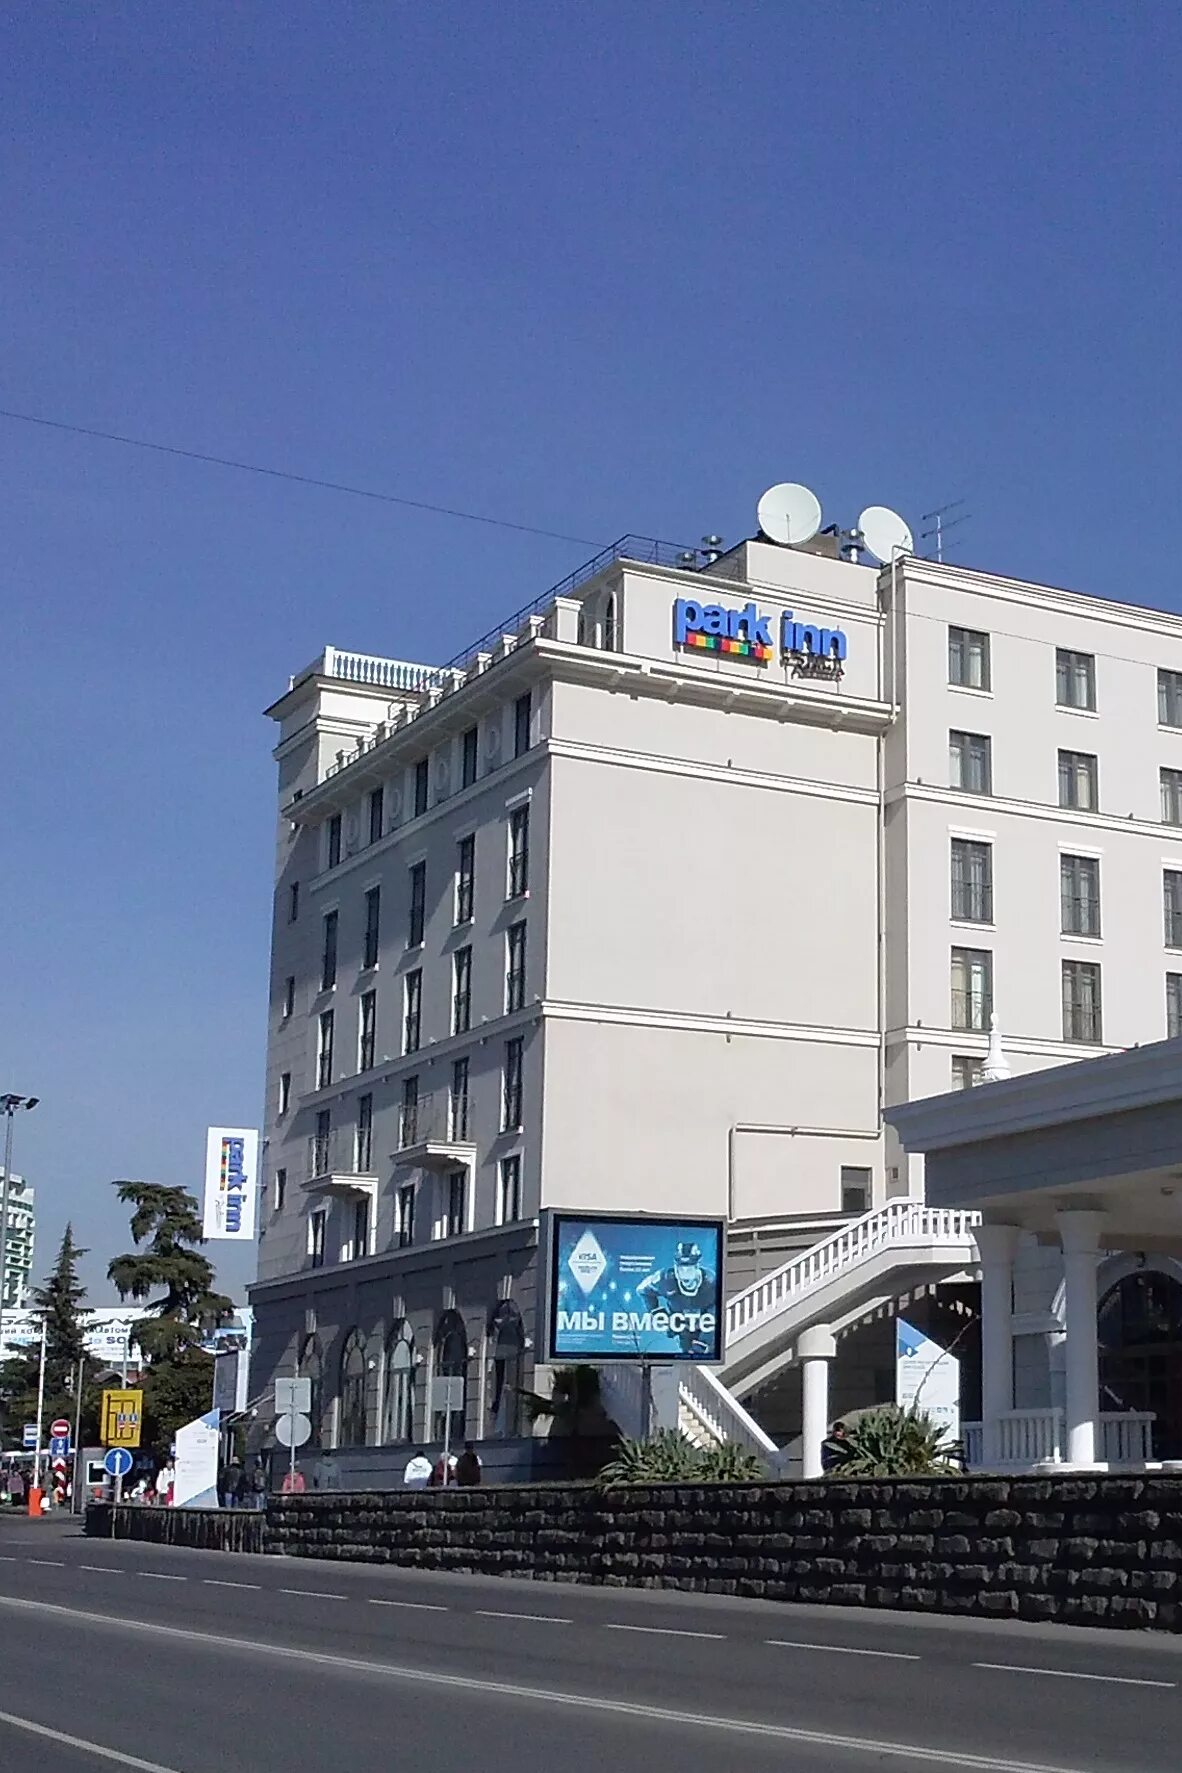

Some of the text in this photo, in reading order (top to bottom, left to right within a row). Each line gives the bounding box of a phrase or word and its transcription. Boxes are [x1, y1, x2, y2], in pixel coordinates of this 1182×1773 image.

[673, 598, 847, 660] park inn
[222, 1137, 248, 1232] park inn
